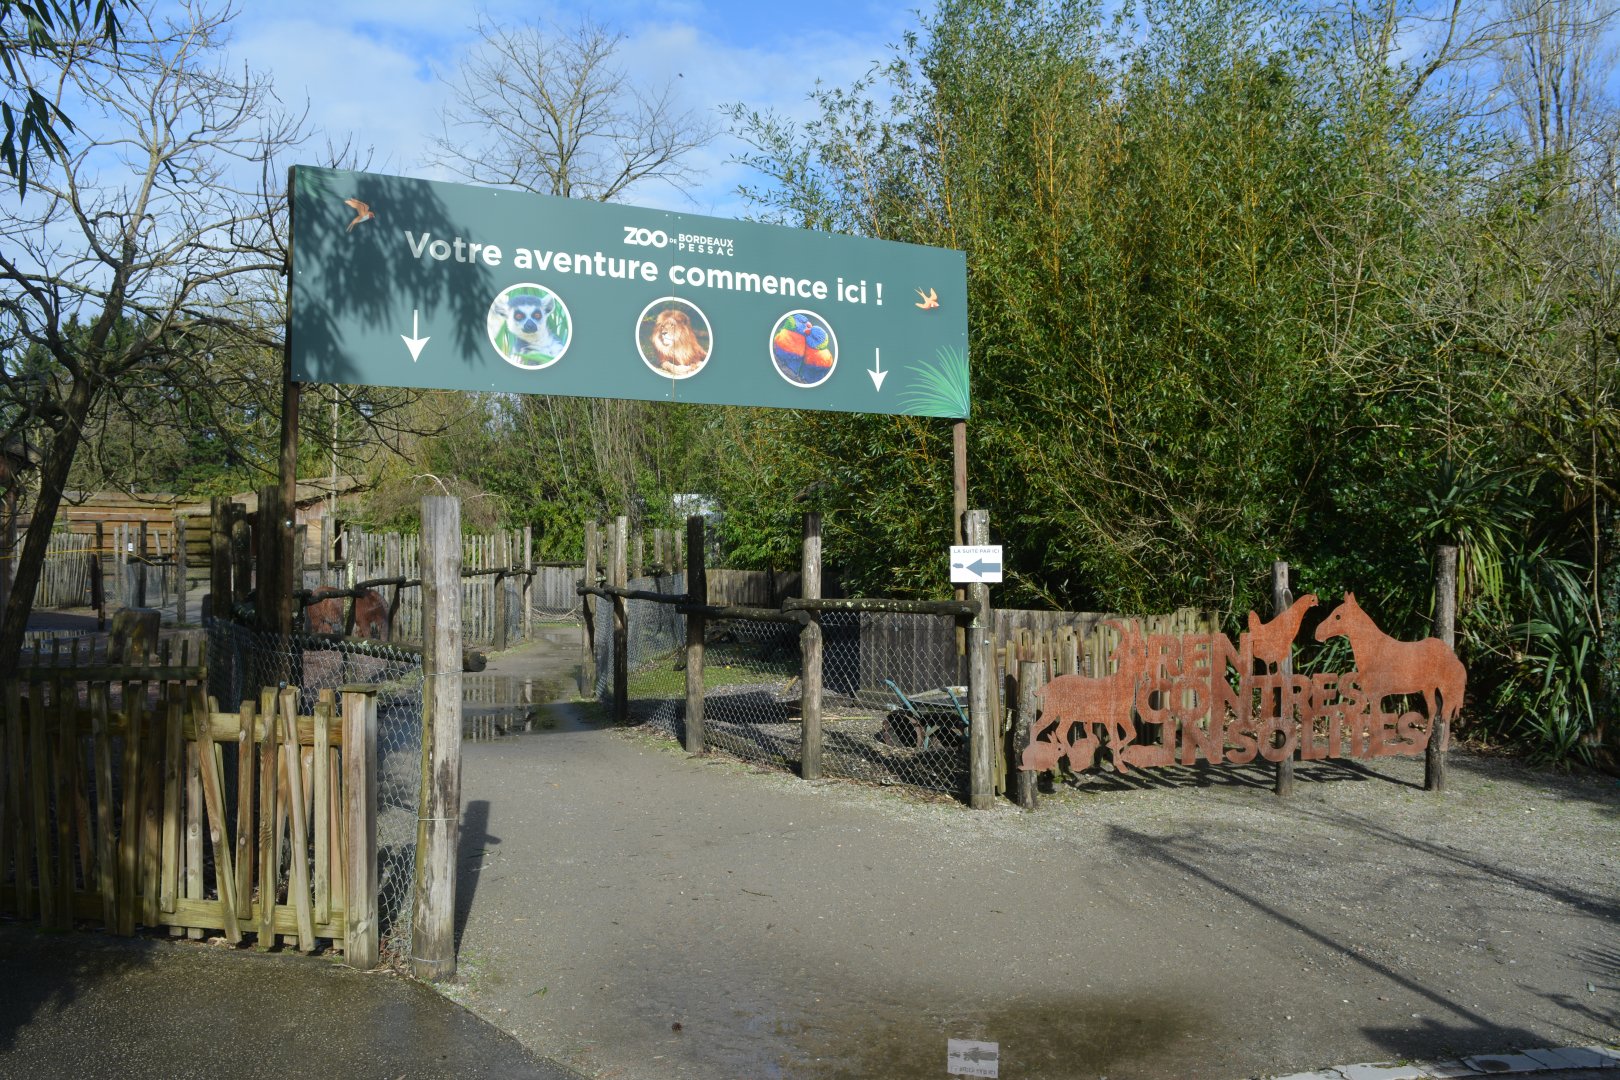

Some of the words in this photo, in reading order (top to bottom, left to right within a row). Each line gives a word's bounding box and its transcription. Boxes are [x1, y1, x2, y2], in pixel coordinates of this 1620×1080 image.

[624, 226, 668, 248] ZOO
[678, 233, 734, 248] BORDEAUX
[678, 242, 734, 257] PESSAC
[404, 230, 502, 266] Votre
[514, 248, 659, 282] aventure
[669, 264, 828, 300] commence
[837, 277, 867, 304] ici
[1147, 632, 1253, 677] REN
[1136, 672, 1369, 724] CONTRES
[1163, 712, 1428, 766] INSOLITES
